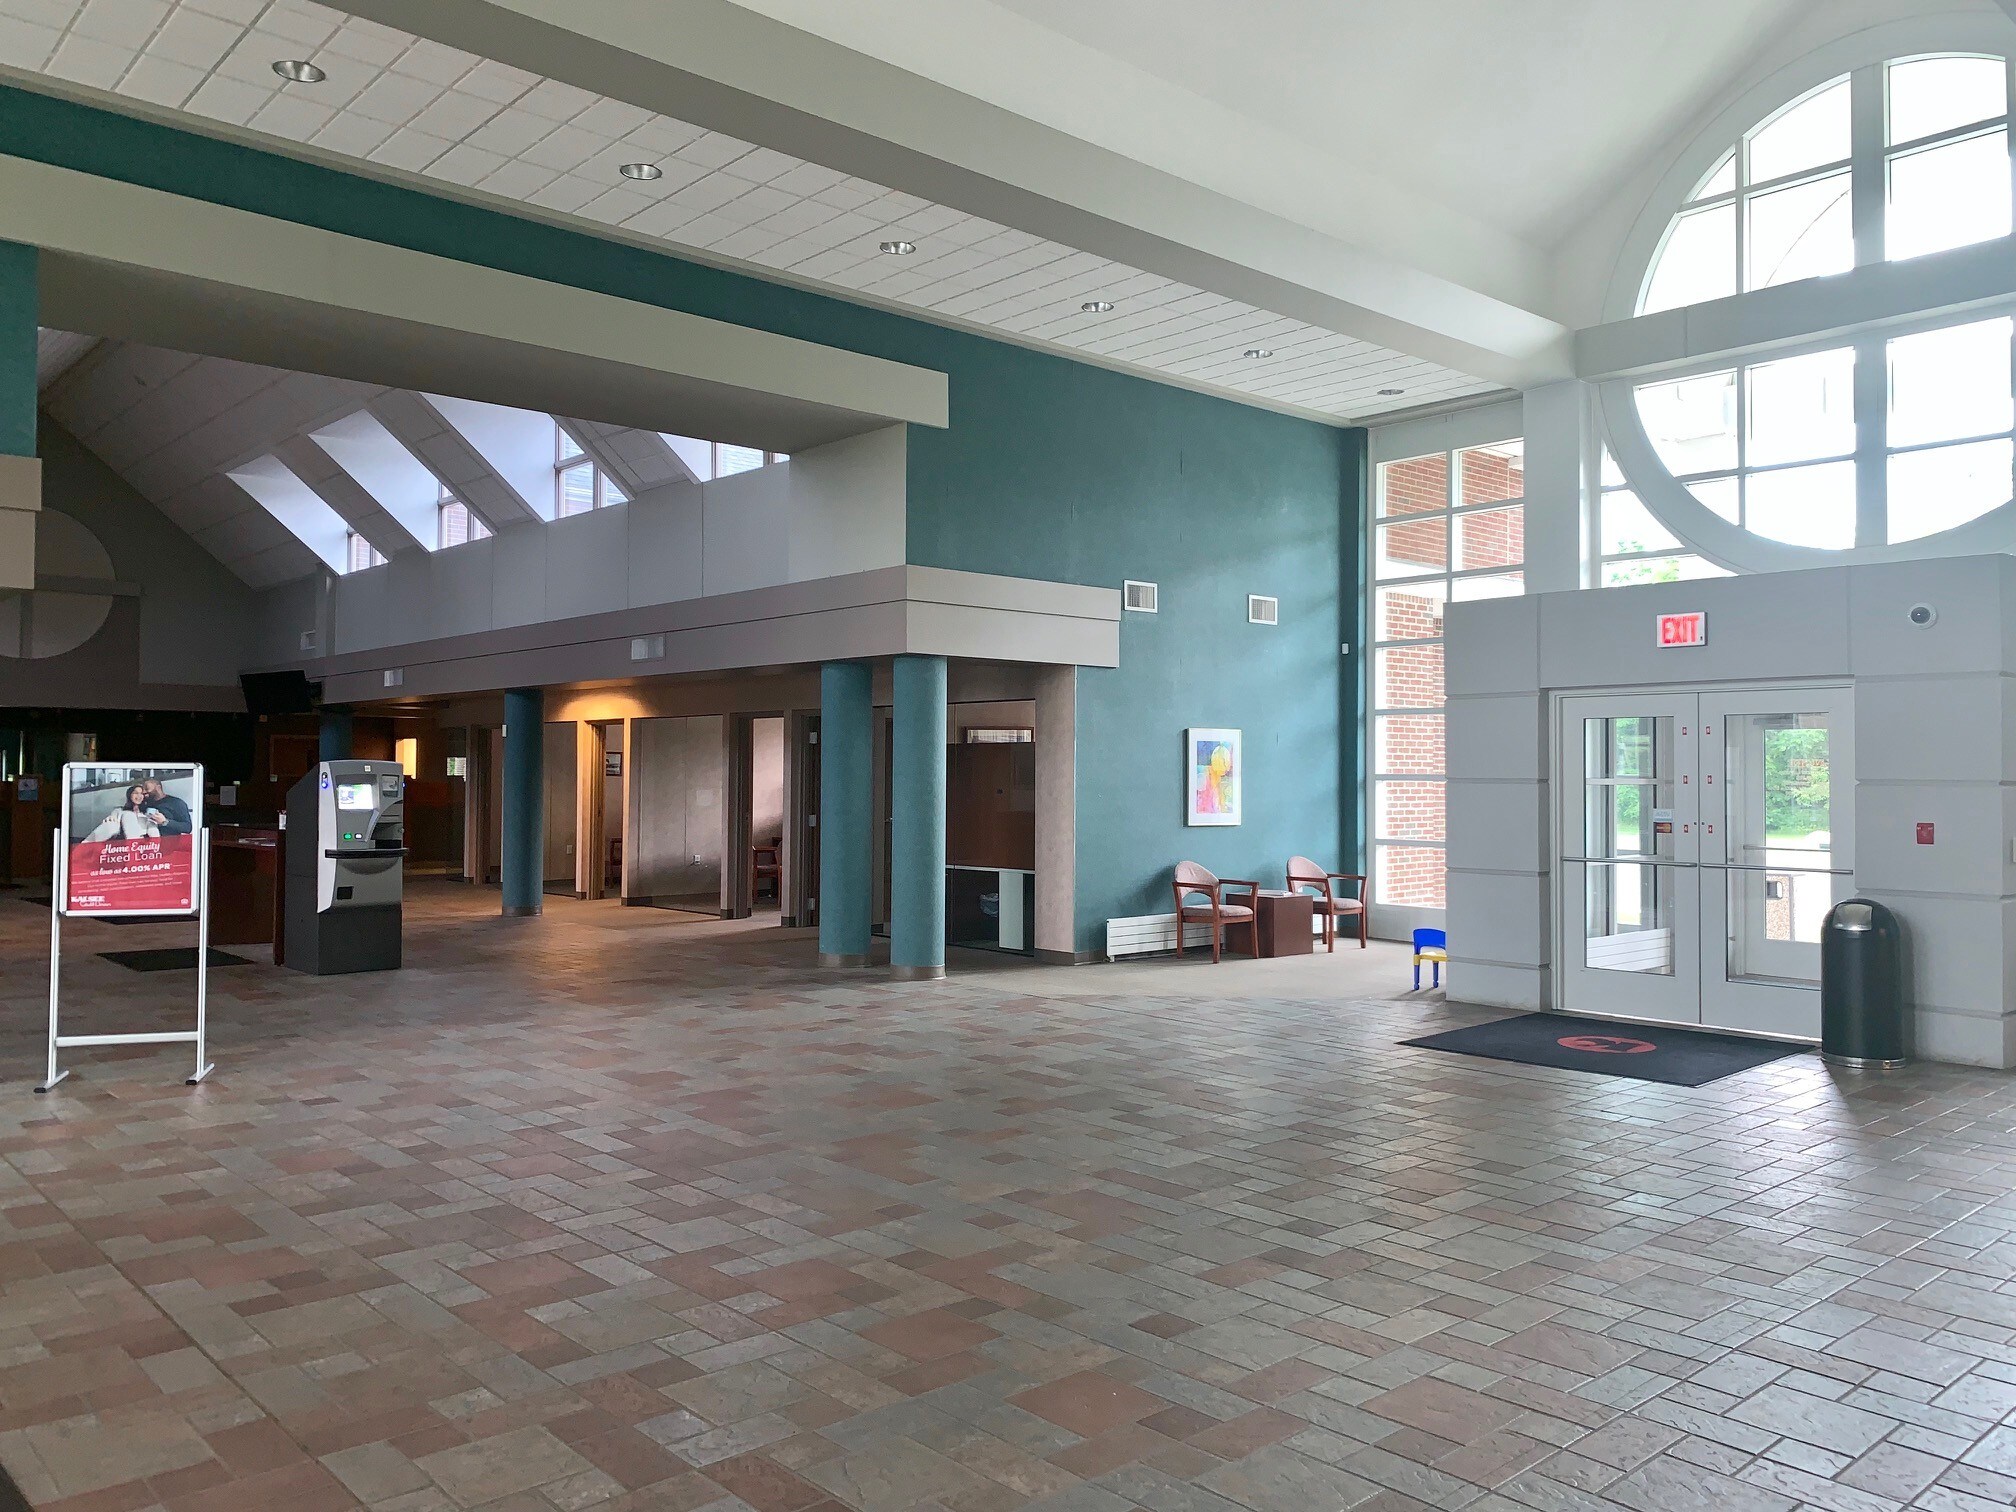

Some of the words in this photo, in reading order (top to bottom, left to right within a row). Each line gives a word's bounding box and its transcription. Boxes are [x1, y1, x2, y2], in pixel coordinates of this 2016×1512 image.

[1662, 615, 1699, 644] EXIT
[101, 844, 130, 854] Home
[131, 842, 160, 854] Equity
[100, 853, 130, 864] Fixed
[135, 852, 163, 861] Loan
[99, 867, 113, 875] low
[122, 865, 150, 874] 4.00%
